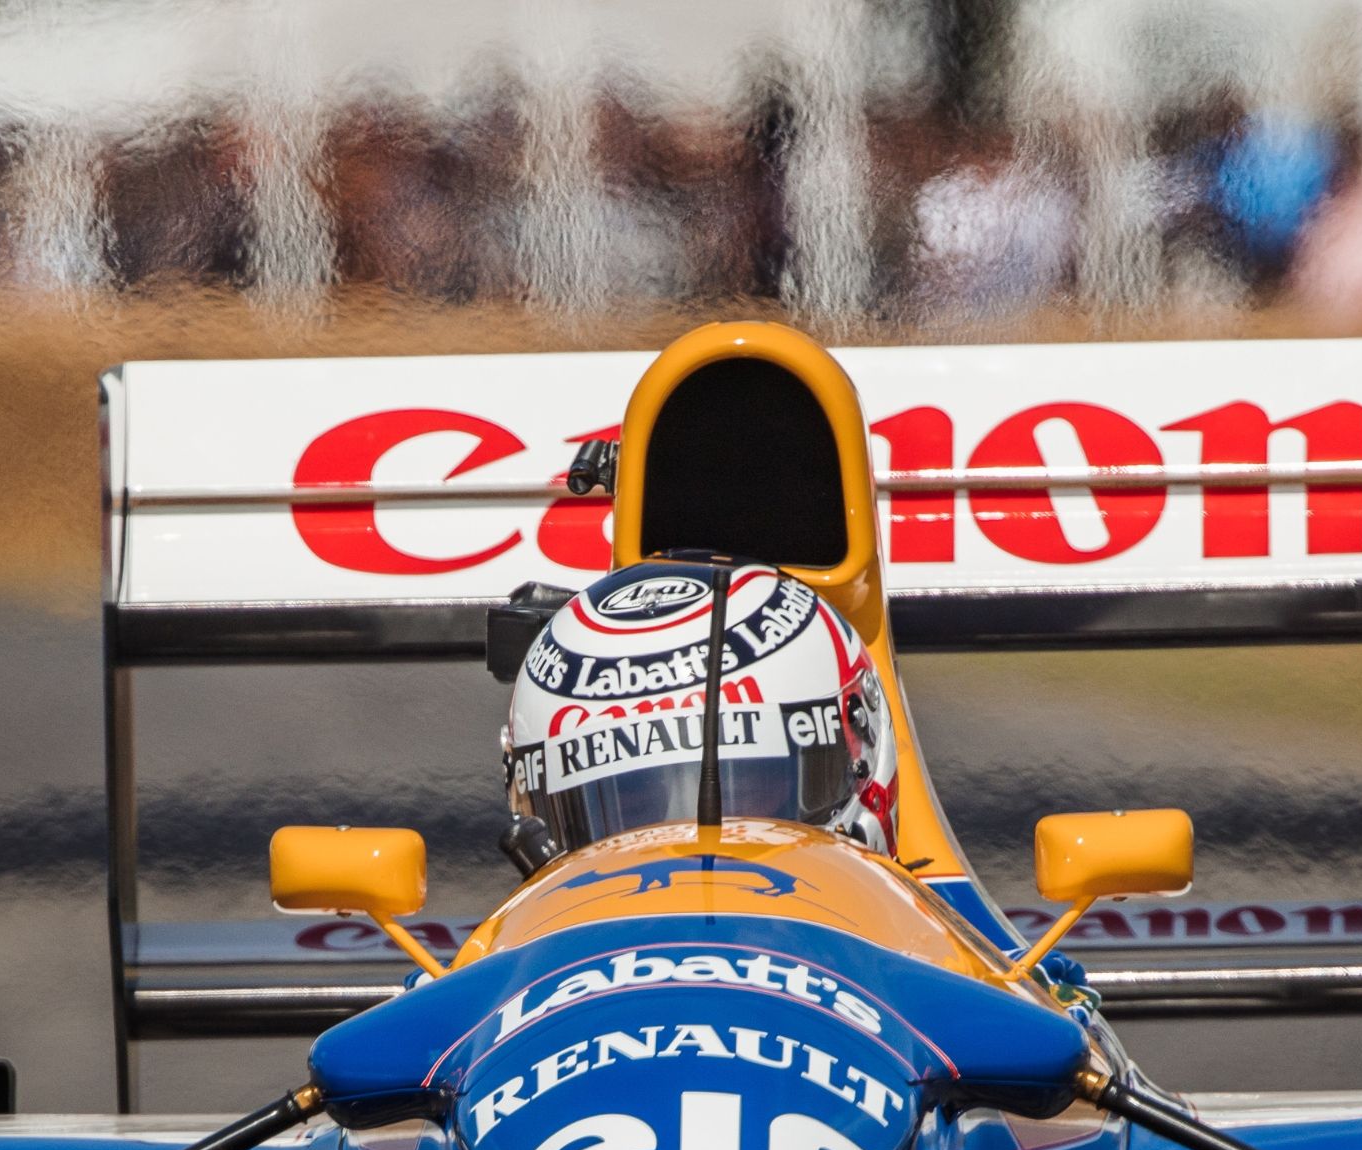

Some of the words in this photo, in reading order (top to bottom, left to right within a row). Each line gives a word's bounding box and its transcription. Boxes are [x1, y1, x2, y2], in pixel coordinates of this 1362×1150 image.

[571, 643, 740, 697] Labatt's
[557, 711, 761, 777] RENAULT
[788, 705, 841, 748] elf
[514, 748, 545, 795] elf
[493, 950, 883, 1044] Labatt's
[469, 1023, 905, 1147] RENAULT
